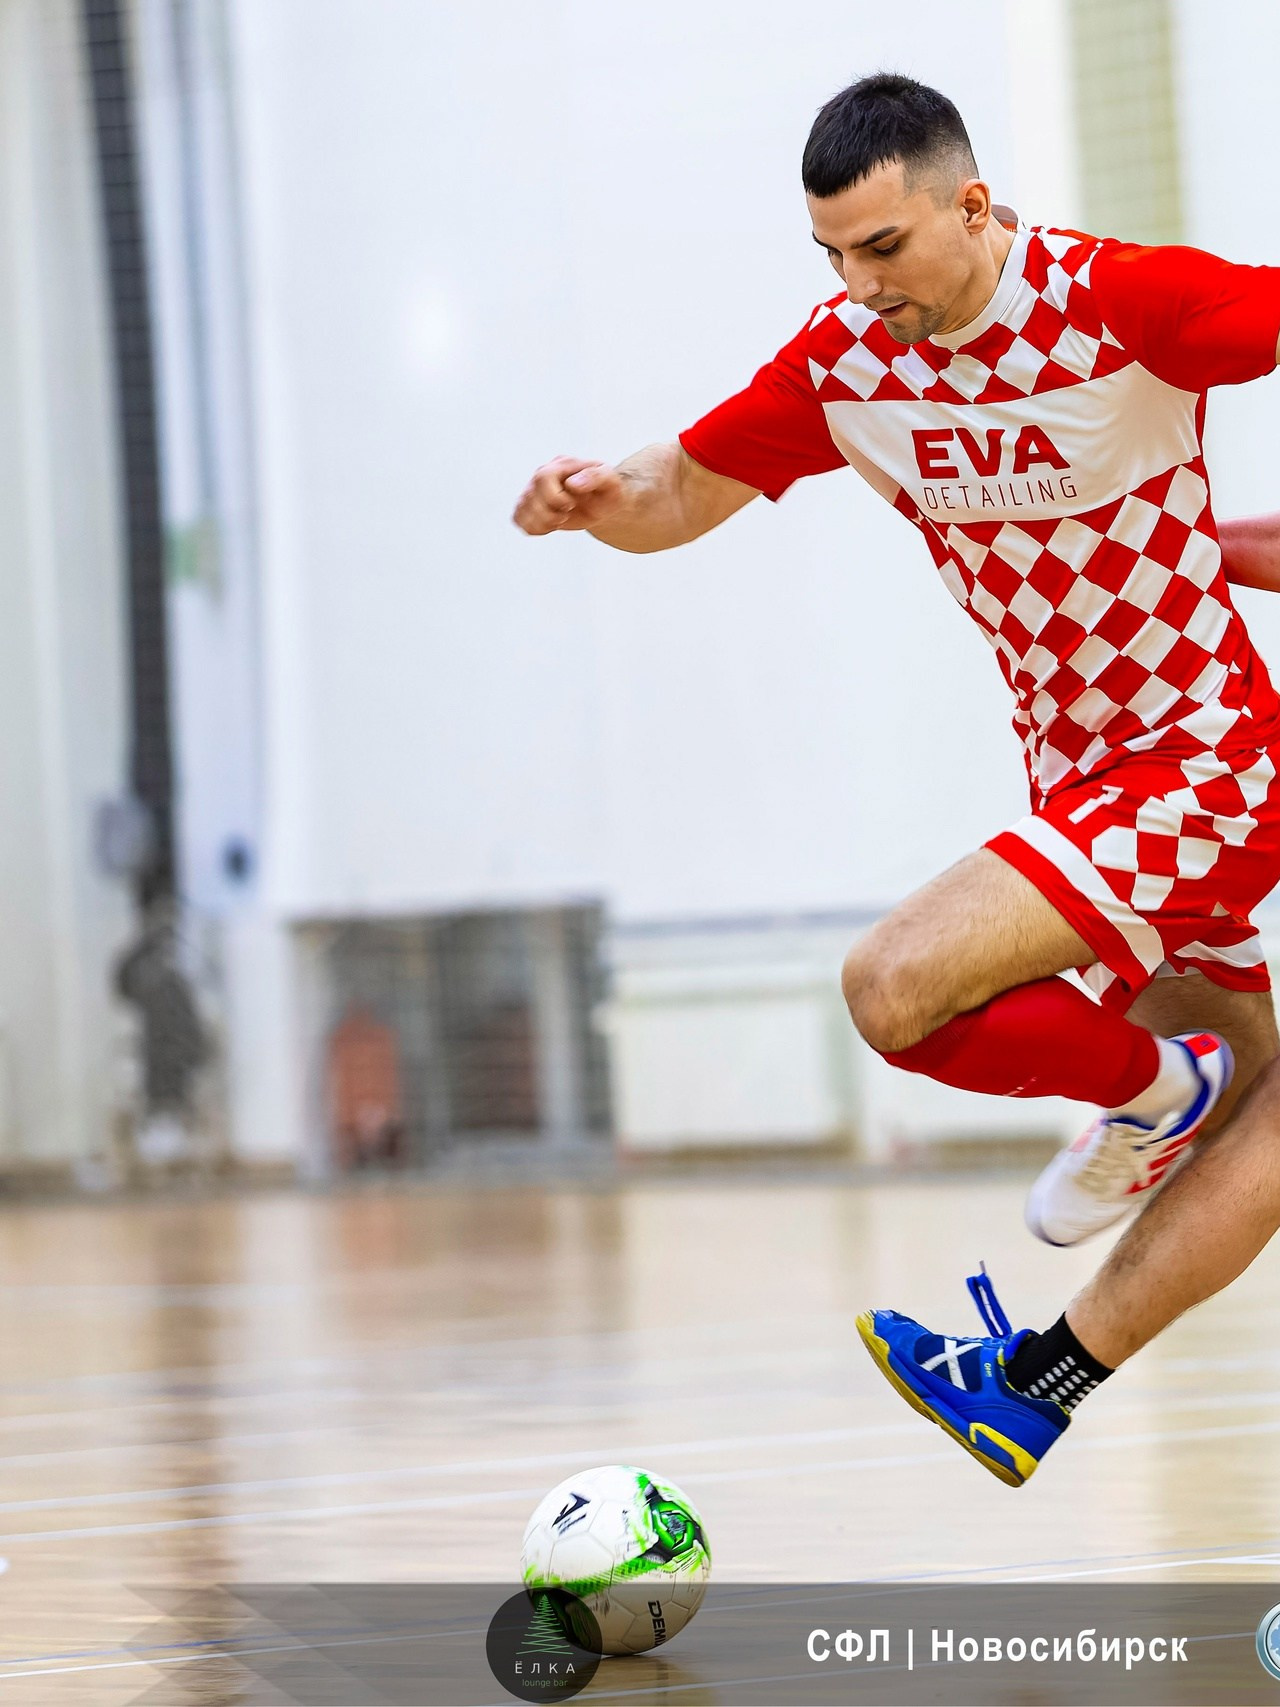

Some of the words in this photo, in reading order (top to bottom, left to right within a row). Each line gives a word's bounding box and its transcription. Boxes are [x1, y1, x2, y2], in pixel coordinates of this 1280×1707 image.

[911, 425, 1071, 479] EVA
[924, 476, 1077, 509] DETAILING
[648, 1600, 666, 1646] DEMI
